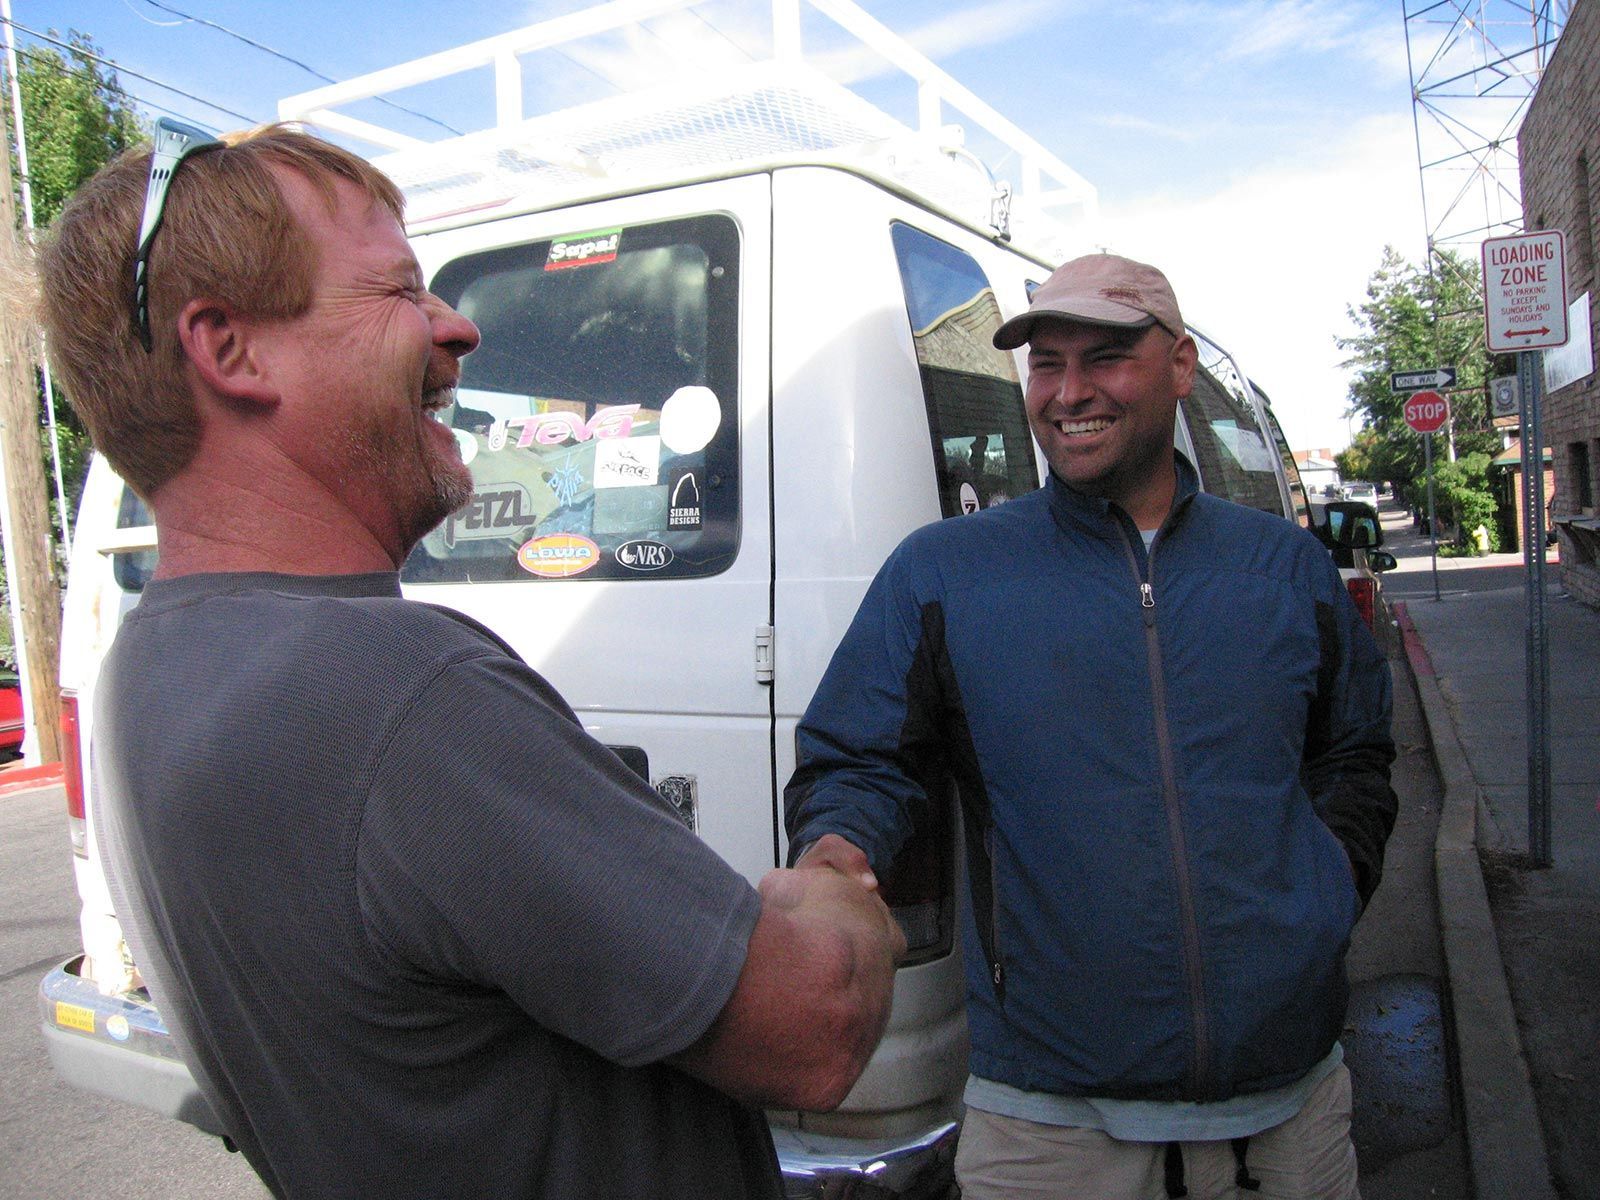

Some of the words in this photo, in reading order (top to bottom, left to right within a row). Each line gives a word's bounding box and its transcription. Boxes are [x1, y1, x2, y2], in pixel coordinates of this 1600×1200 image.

[1491, 242, 1554, 266] LOADING
[1500, 264, 1548, 286] ZONE
[1503, 289, 1513, 297] NO
[1516, 285, 1546, 296] PARKING
[1511, 297, 1538, 305] EXCEPT
[1501, 305, 1533, 315] SUNDAYS
[1536, 303, 1550, 311] AND
[1509, 313, 1543, 323] HOLIDAYS
[1397, 377, 1415, 387] ONE
[1419, 374, 1437, 385] WAY
[1407, 403, 1444, 421] STOP
[670, 507, 700, 518] SIERRA
[669, 516, 700, 525] DESIGNS
[526, 547, 592, 560] LOWA
[634, 545, 666, 566] NRS
